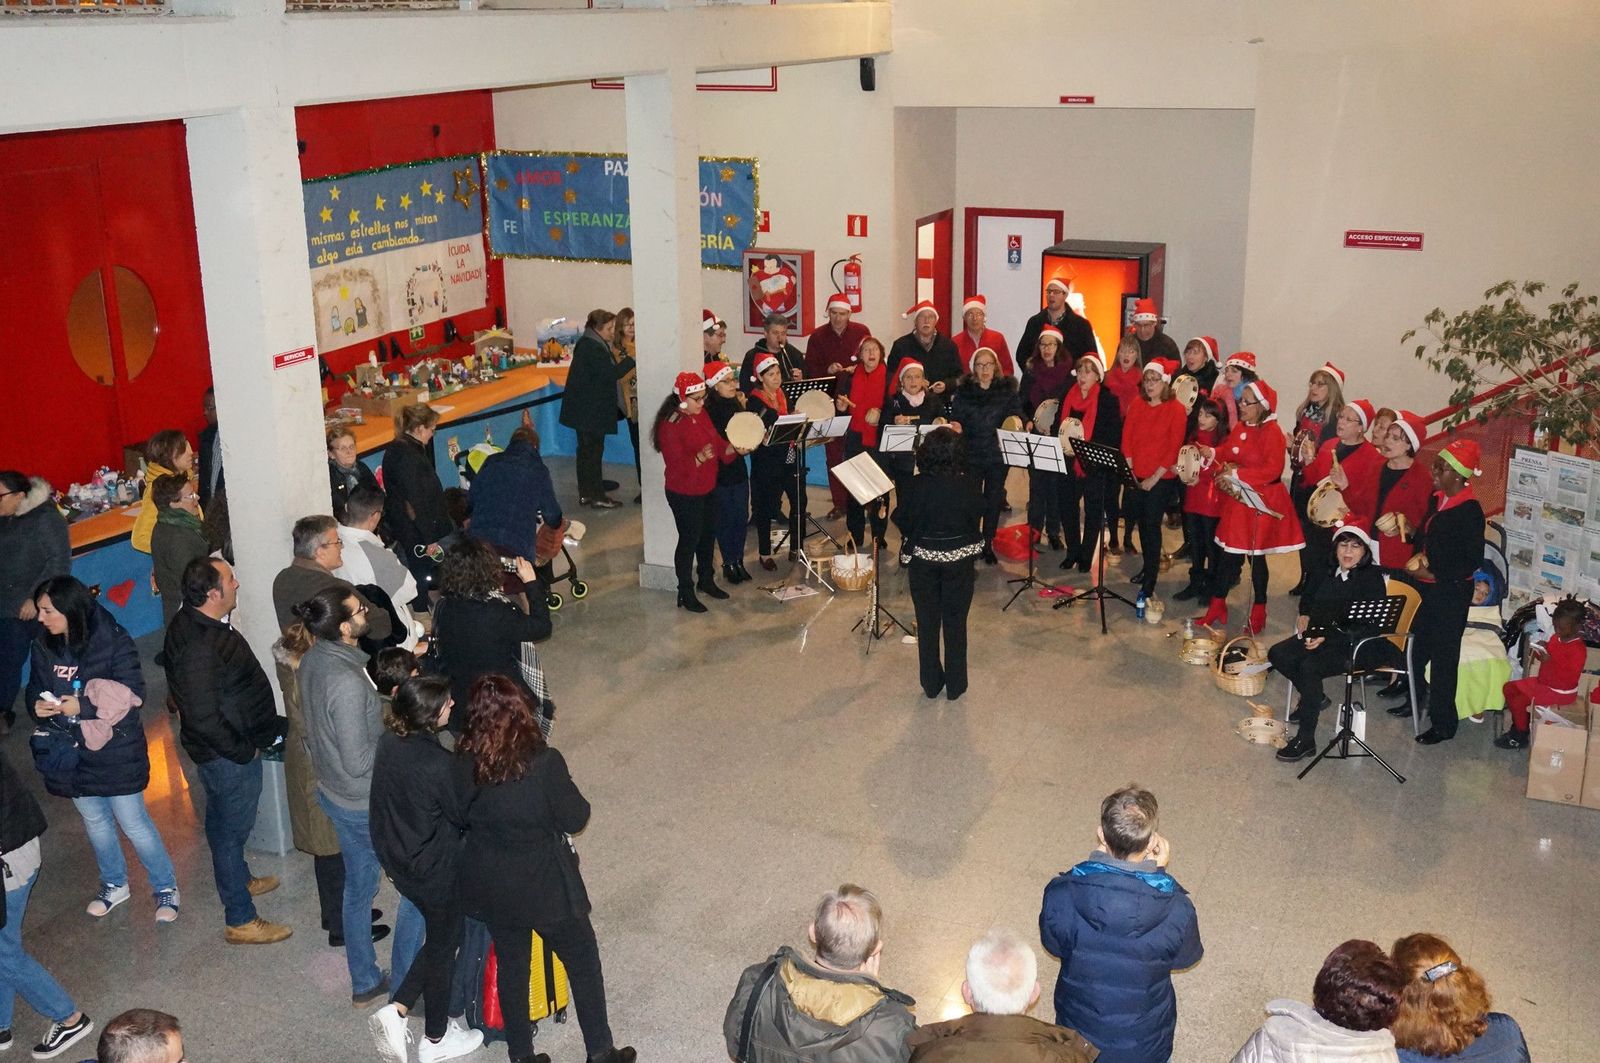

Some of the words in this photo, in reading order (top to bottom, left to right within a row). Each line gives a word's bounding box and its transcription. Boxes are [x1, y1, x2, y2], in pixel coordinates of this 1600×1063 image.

[515, 170, 562, 186] AMOR
[311, 231, 345, 246] mismas
[395, 219, 409, 229] nos
[415, 214, 438, 226] miran
[503, 219, 518, 234] FE
[1374, 235, 1420, 243] ESPECTADORES
[317, 247, 339, 269] algo
[456, 258, 466, 269] LA
